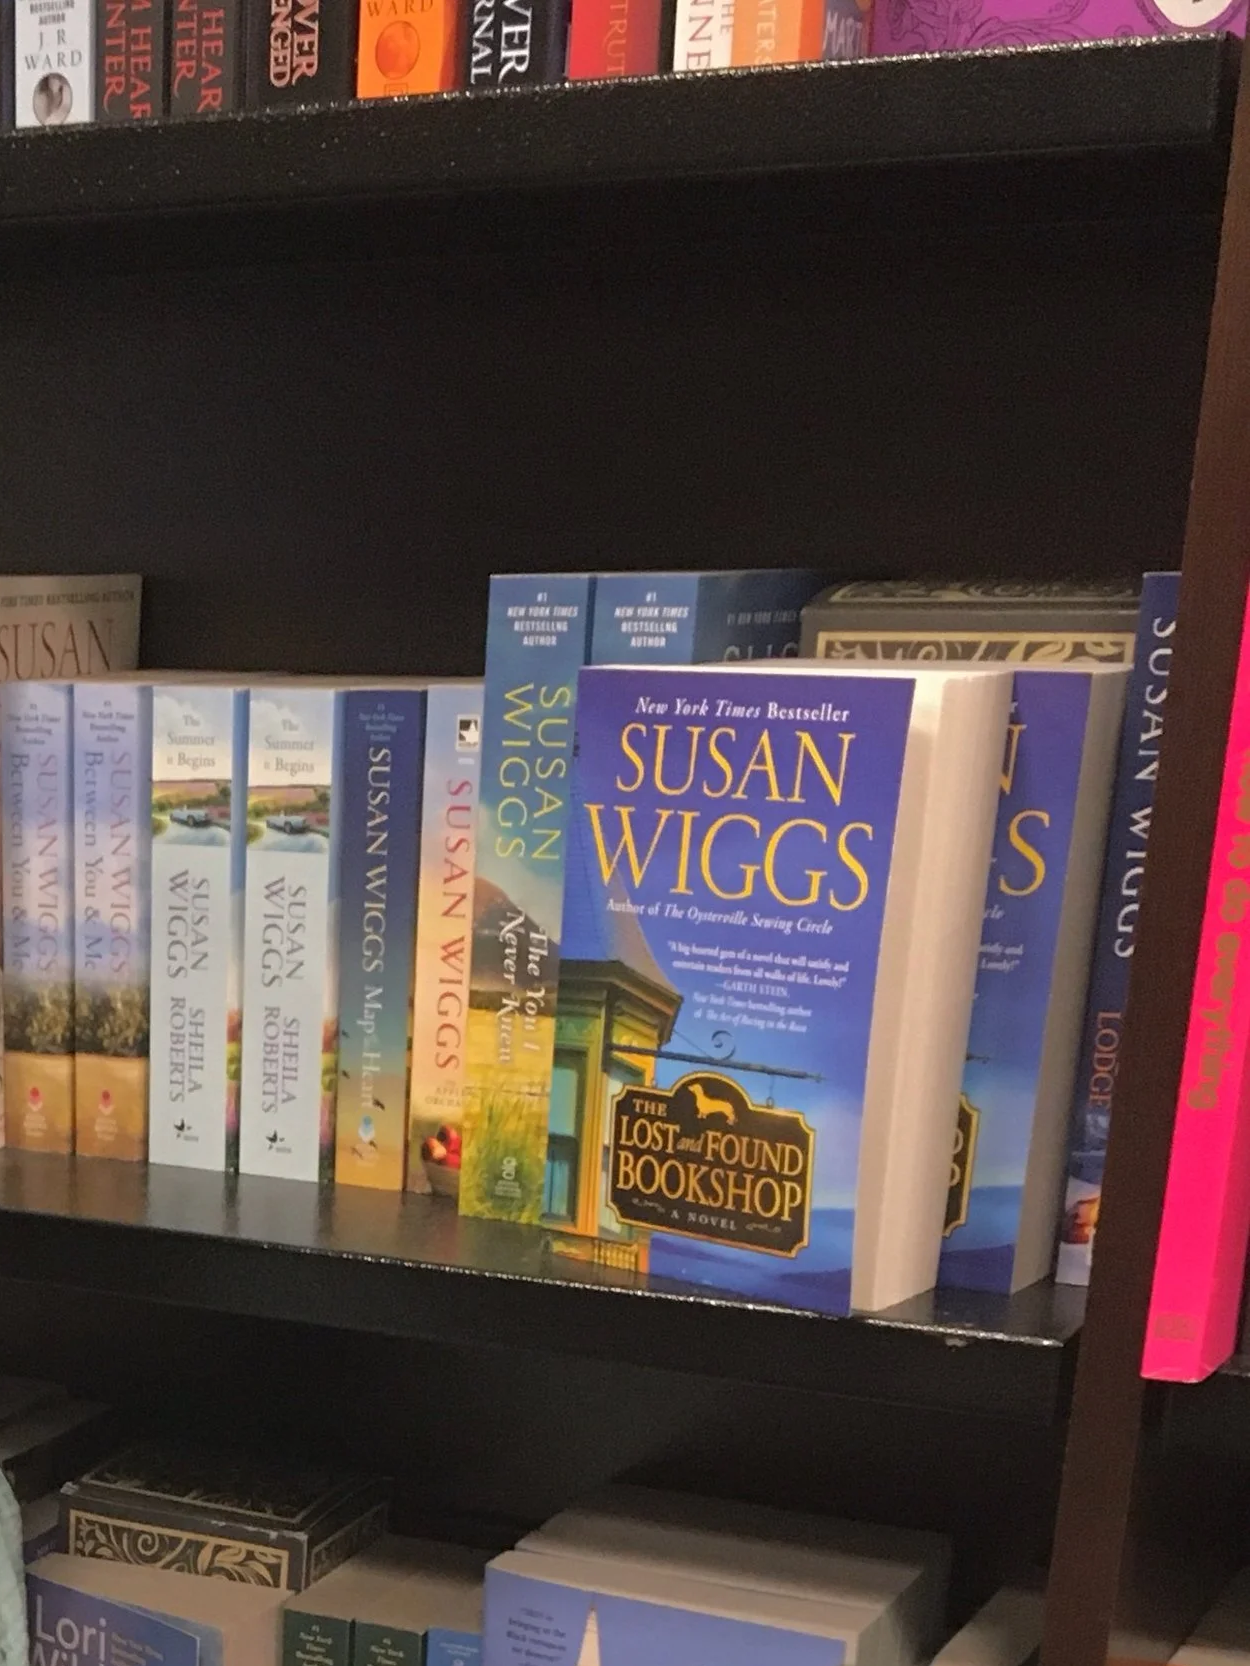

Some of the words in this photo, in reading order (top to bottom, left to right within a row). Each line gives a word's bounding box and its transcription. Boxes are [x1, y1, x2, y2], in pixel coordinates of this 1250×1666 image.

[24, 50, 83, 70] WARD
[507, 606, 528, 618] NEW
[529, 606, 551, 617] YORK
[553, 606, 579, 617] TIMES
[522, 635, 557, 646] AUTHOR
[167, 731, 216, 748] Summer
[183, 714, 201, 727] The
[635, 696, 668, 715] New
[674, 697, 709, 717] York
[714, 700, 761, 719] Times
[767, 701, 851, 723] Bestseller
[9, 751, 31, 851] Between
[84, 751, 104, 849] Between
[110, 751, 132, 857] SUSAN
[177, 752, 216, 769] Begins
[365, 746, 392, 857] SUSAN
[495, 683, 535, 860] WIGGS
[531, 684, 571, 862] SUSAN
[616, 722, 856, 807] SUSAN
[36, 753, 59, 861] SUSAN
[441, 778, 474, 920] SUSAN
[10, 856, 31, 901] You
[84, 854, 104, 900] You
[583, 803, 875, 912] WIGGS
[36, 867, 60, 973] WIGGS
[84, 934, 103, 970] Me
[109, 865, 132, 975] WIGGS
[166, 868, 190, 980] WIGGS
[191, 876, 210, 972] SUSAN
[261, 875, 286, 989] WIGGS
[286, 885, 308, 981] SUSAN
[362, 862, 387, 974] WIGGS
[499, 907, 526, 982] Never
[606, 898, 644, 916] Author
[648, 903, 661, 916] of
[663, 903, 685, 920] The
[686, 908, 749, 926] Oysterville
[750, 914, 793, 935] Sewing
[796, 917, 834, 936] Circle
[168, 995, 187, 1103] ROBERTS
[361, 985, 384, 1034] Map
[434, 941, 467, 1071] WIGGS
[522, 986, 546, 1031] You
[1186, 930, 1242, 1111] everything
[187, 1007, 205, 1095] SHEILA
[261, 1005, 281, 1114] ROBERTS
[280, 1016, 300, 1106] SHEILA
[619, 1115, 681, 1154] LOST
[676, 1133, 705, 1154] and
[704, 1130, 804, 1177] FOUND
[633, 1098, 668, 1118] THE
[616, 1150, 803, 1223] BOOKSHOP
[688, 1211, 738, 1231] NOVEL
[36, 1594, 108, 1662] Lori
